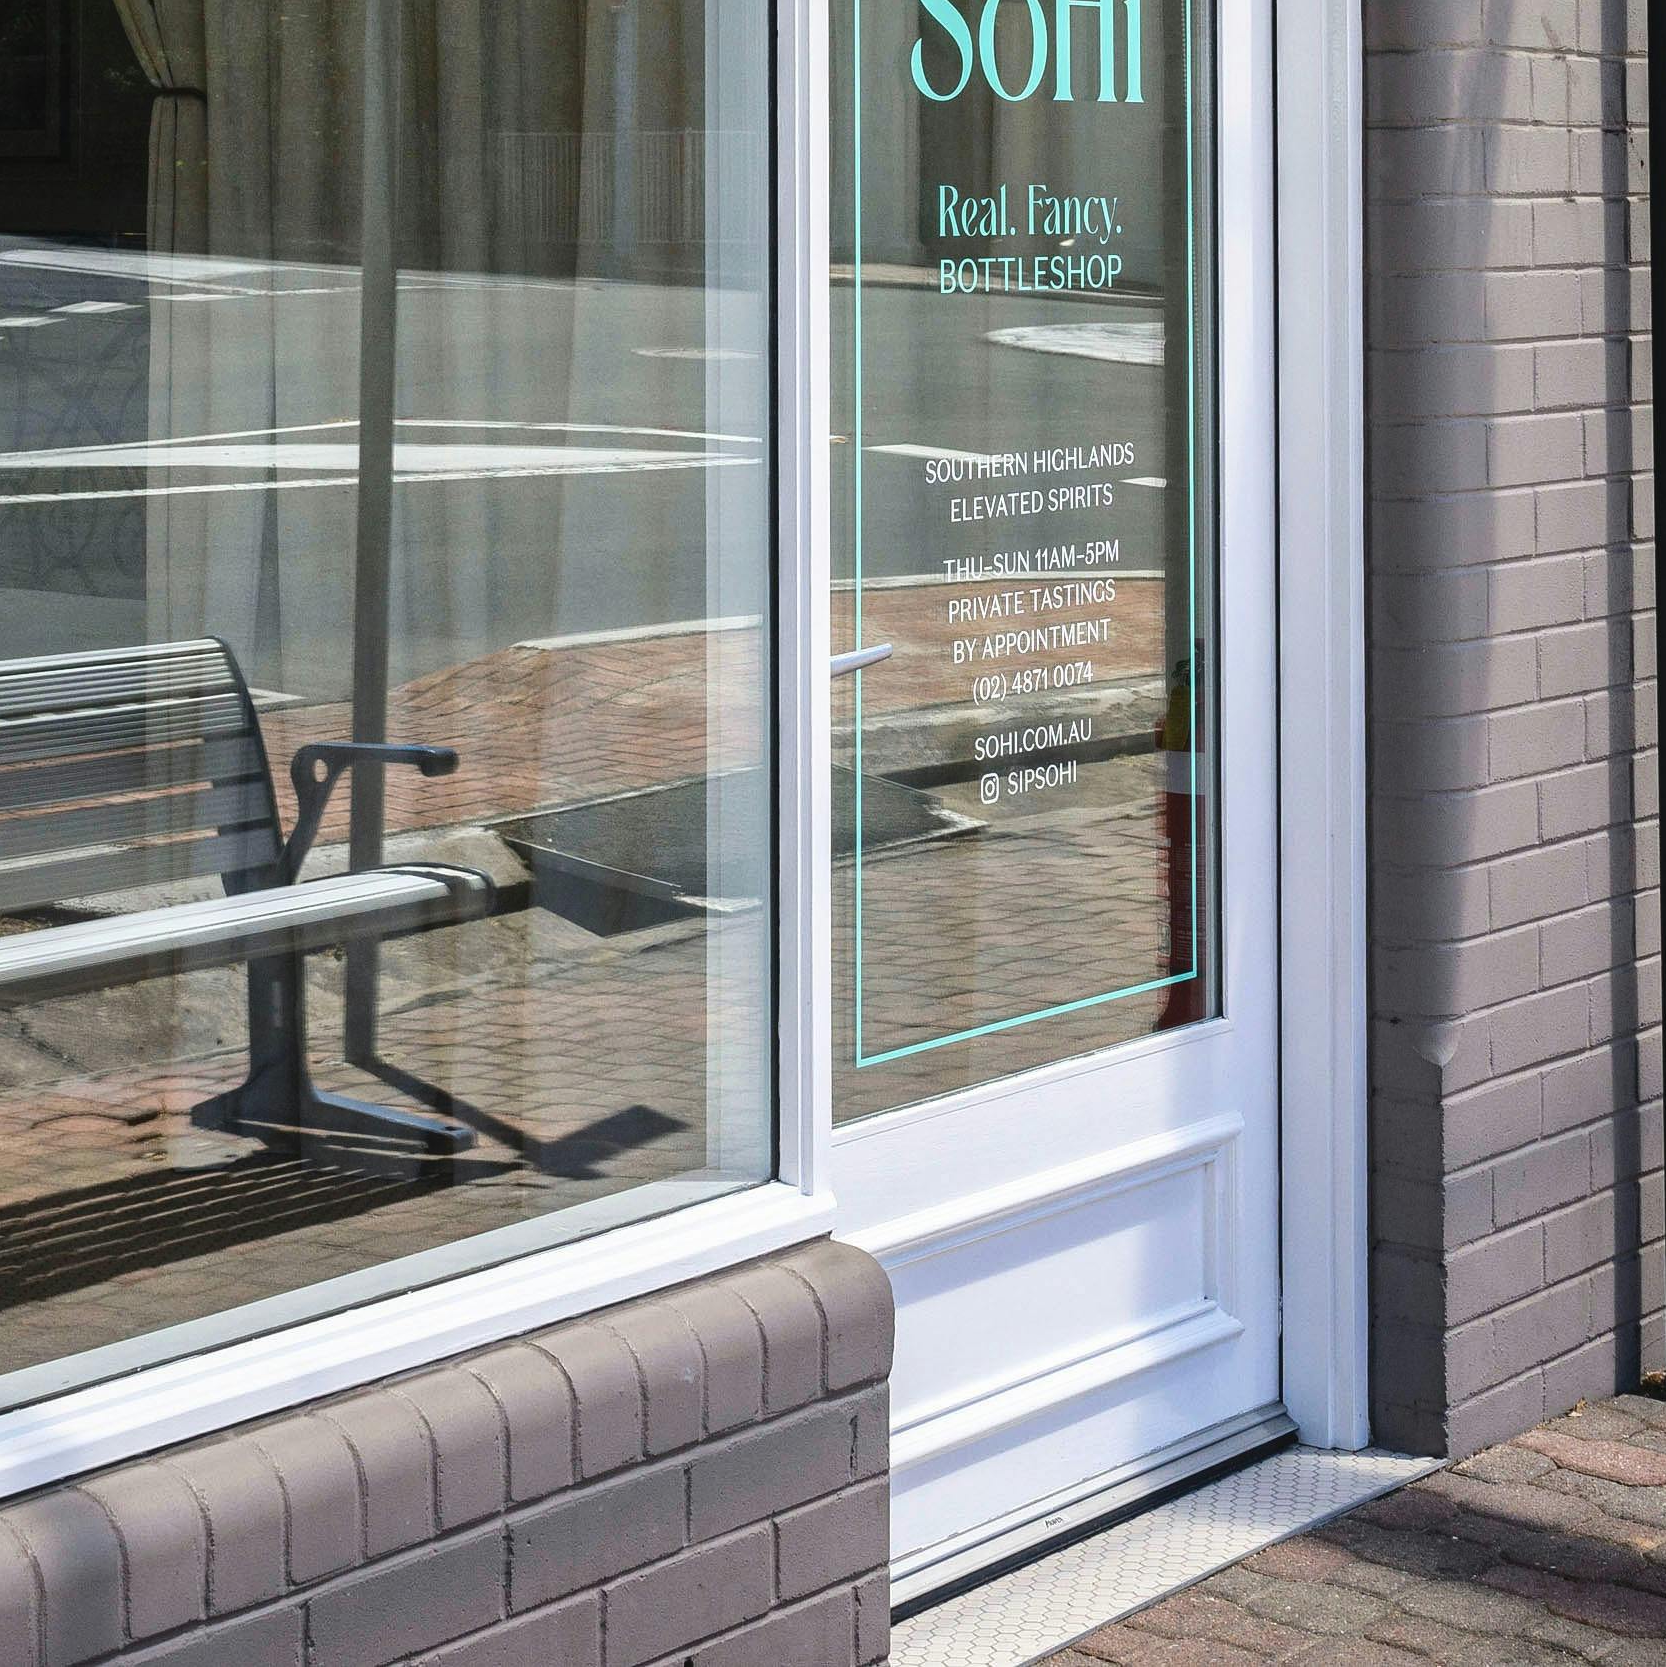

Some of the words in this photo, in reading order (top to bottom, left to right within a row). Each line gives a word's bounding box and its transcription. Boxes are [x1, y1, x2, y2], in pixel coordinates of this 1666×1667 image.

[938, 184, 1017, 238] Real.
[1027, 183, 1122, 245] Fancy.
[939, 253, 1122, 295] BOTTLESHOP
[925, 451, 1028, 484] SOUTHERN
[1033, 442, 1135, 474] HIGHLANDS
[950, 490, 1044, 522] ELEVATED
[1048, 483, 1113, 512] SPIRITS
[948, 590, 1025, 624] PRIVATE
[1029, 578, 1116, 612] TASTINGS
[953, 637, 977, 664] BY
[982, 618, 1112, 660] APPOINTMENT
[972, 672, 1007, 705] (02)
[1011, 667, 1048, 695] 4871
[1053, 660, 1094, 688] 0074
[974, 718, 1093, 762] SOHI.COM.AU
[1007, 760, 1078, 796] SIPSOHI
